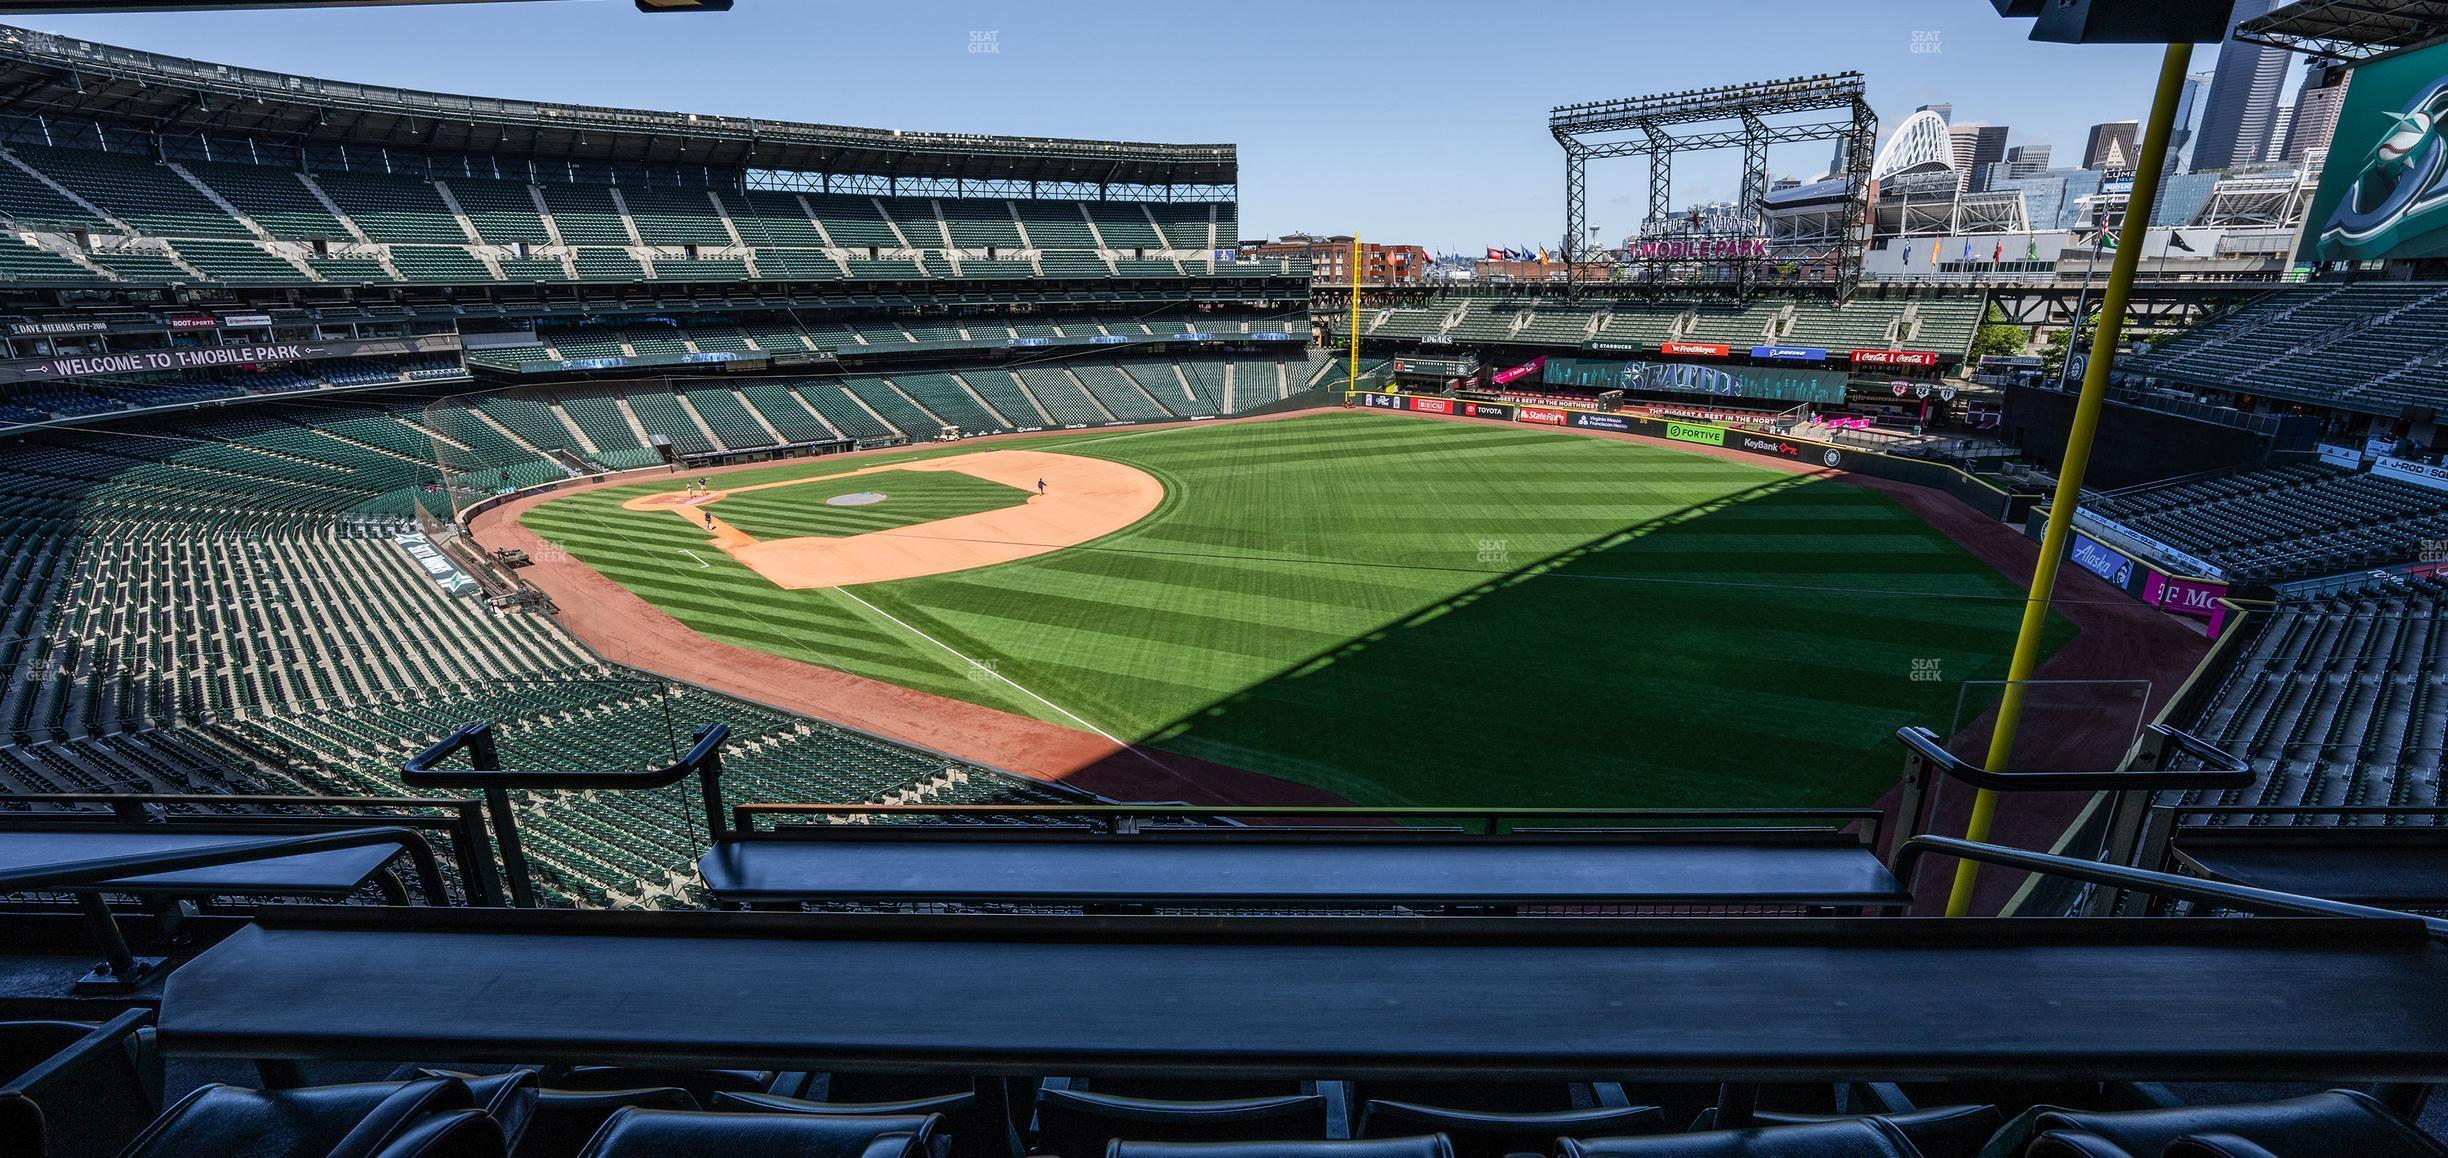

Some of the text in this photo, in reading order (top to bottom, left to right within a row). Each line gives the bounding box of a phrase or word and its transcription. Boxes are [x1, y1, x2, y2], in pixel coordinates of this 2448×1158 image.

[1714, 239, 1769, 257] PARK
[19, 324, 42, 334] DAVE
[42, 323, 76, 333] NIEHAUS
[172, 319, 192, 327] ROOT
[54, 345, 301, 376] WELCOME TO T-MOBILE PARK
[1420, 401, 1443, 409] BECU
[1478, 406, 1502, 415] TOYOTA
[1559, 401, 1599, 409] NORTHWEST
[1704, 412, 1724, 420] BEST
[1682, 428, 1721, 441] FORTIVE
[1744, 438, 1778, 452] KeyBank
[2391, 460, 2424, 474] J-ROD
[2076, 544, 2111, 574] Alaska
